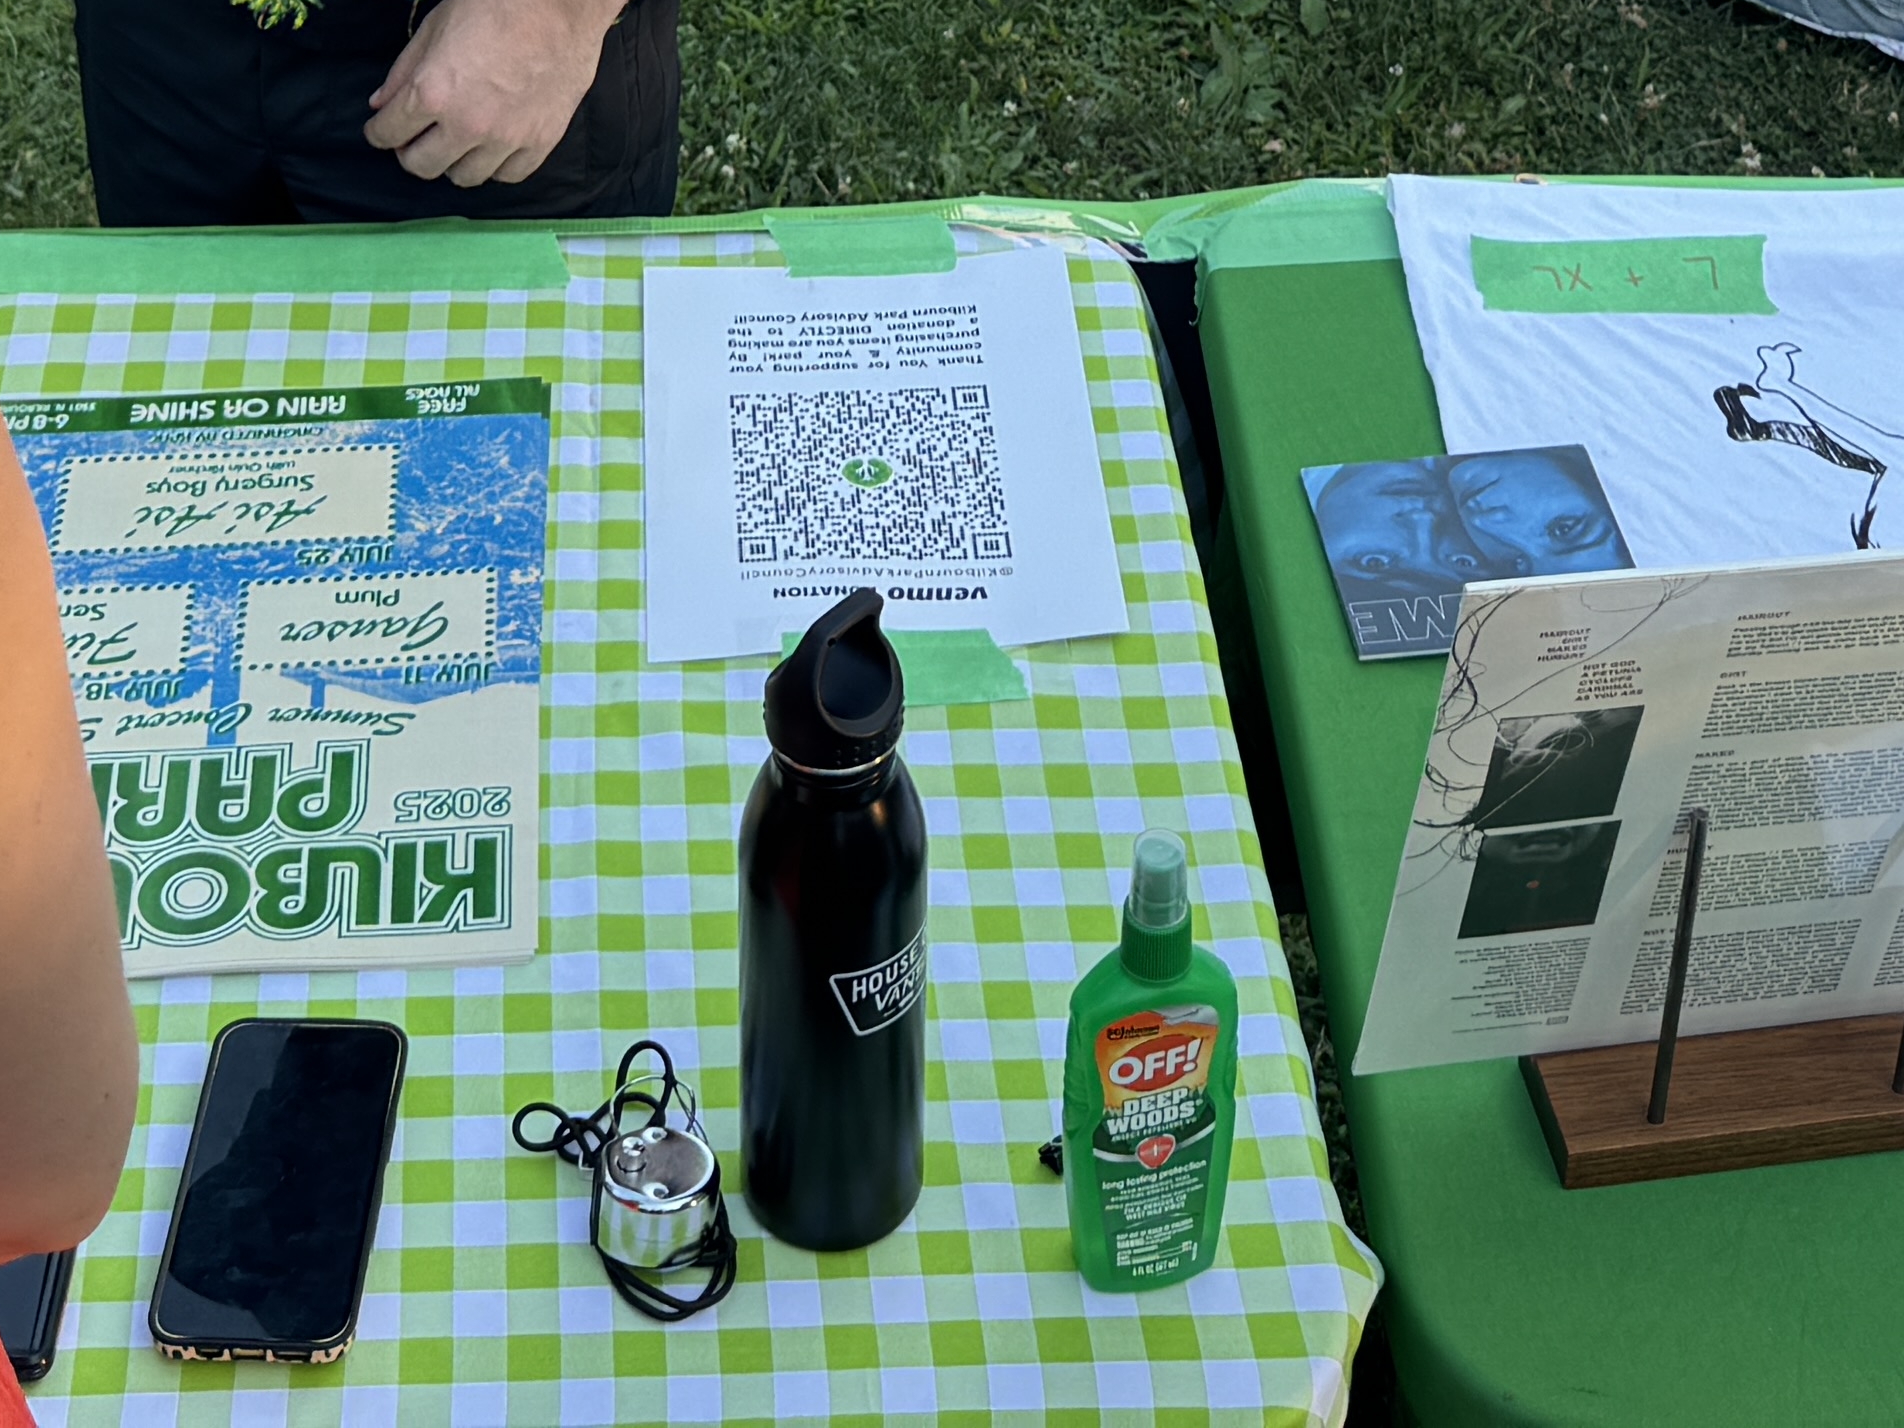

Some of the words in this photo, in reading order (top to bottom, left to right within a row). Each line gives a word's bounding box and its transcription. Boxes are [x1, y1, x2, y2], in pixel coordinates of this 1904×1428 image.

[1532, 263, 1593, 292] XL
[801, 312, 868, 323] Advisory
[875, 311, 907, 320] Park
[913, 305, 976, 316] Kilbourn
[734, 314, 796, 324] Council!
[887, 319, 955, 331] donation
[728, 328, 751, 337] the
[799, 325, 871, 336] DIRECTLY
[896, 329, 979, 343] purchasing
[728, 339, 784, 350] making
[818, 338, 844, 347] you
[848, 336, 891, 347] items
[729, 352, 747, 362] By
[763, 350, 802, 362] park!
[818, 349, 852, 360] your
[869, 350, 879, 358] &
[896, 342, 981, 357] community
[773, 361, 858, 374] supporting
[868, 361, 889, 370] for
[900, 359, 927, 369] You
[938, 355, 983, 366] Thank
[729, 364, 763, 374] your
[405, 385, 445, 401] AGES
[448, 384, 480, 398] ALL
[130, 401, 216, 423] SHINE
[223, 399, 269, 419] OR
[275, 394, 346, 417] RAIN
[418, 399, 467, 413] FREE
[30, 413, 70, 430] 6-8
[145, 477, 206, 497] Boys
[215, 474, 315, 492] Surgery
[297, 547, 332, 565] 25
[336, 545, 393, 563] JULY
[335, 588, 401, 607] Plum
[774, 586, 876, 599] ONATION
[888, 586, 988, 601] venmo
[279, 601, 448, 653] Ganser
[403, 665, 427, 685] 11
[438, 663, 493, 685] JULY
[86, 683, 111, 701] 18
[126, 679, 181, 702] JULY
[115, 703, 252, 738] Concert
[267, 707, 416, 736] Summer
[394, 786, 512, 822] 2025
[852, 942, 919, 1003] HOUSE
[1109, 1038, 1201, 1085] OFF!
[1123, 1087, 1188, 1116] DEEP
[1126, 1173, 1157, 1186] lasting
[1159, 1160, 1207, 1180] protection
